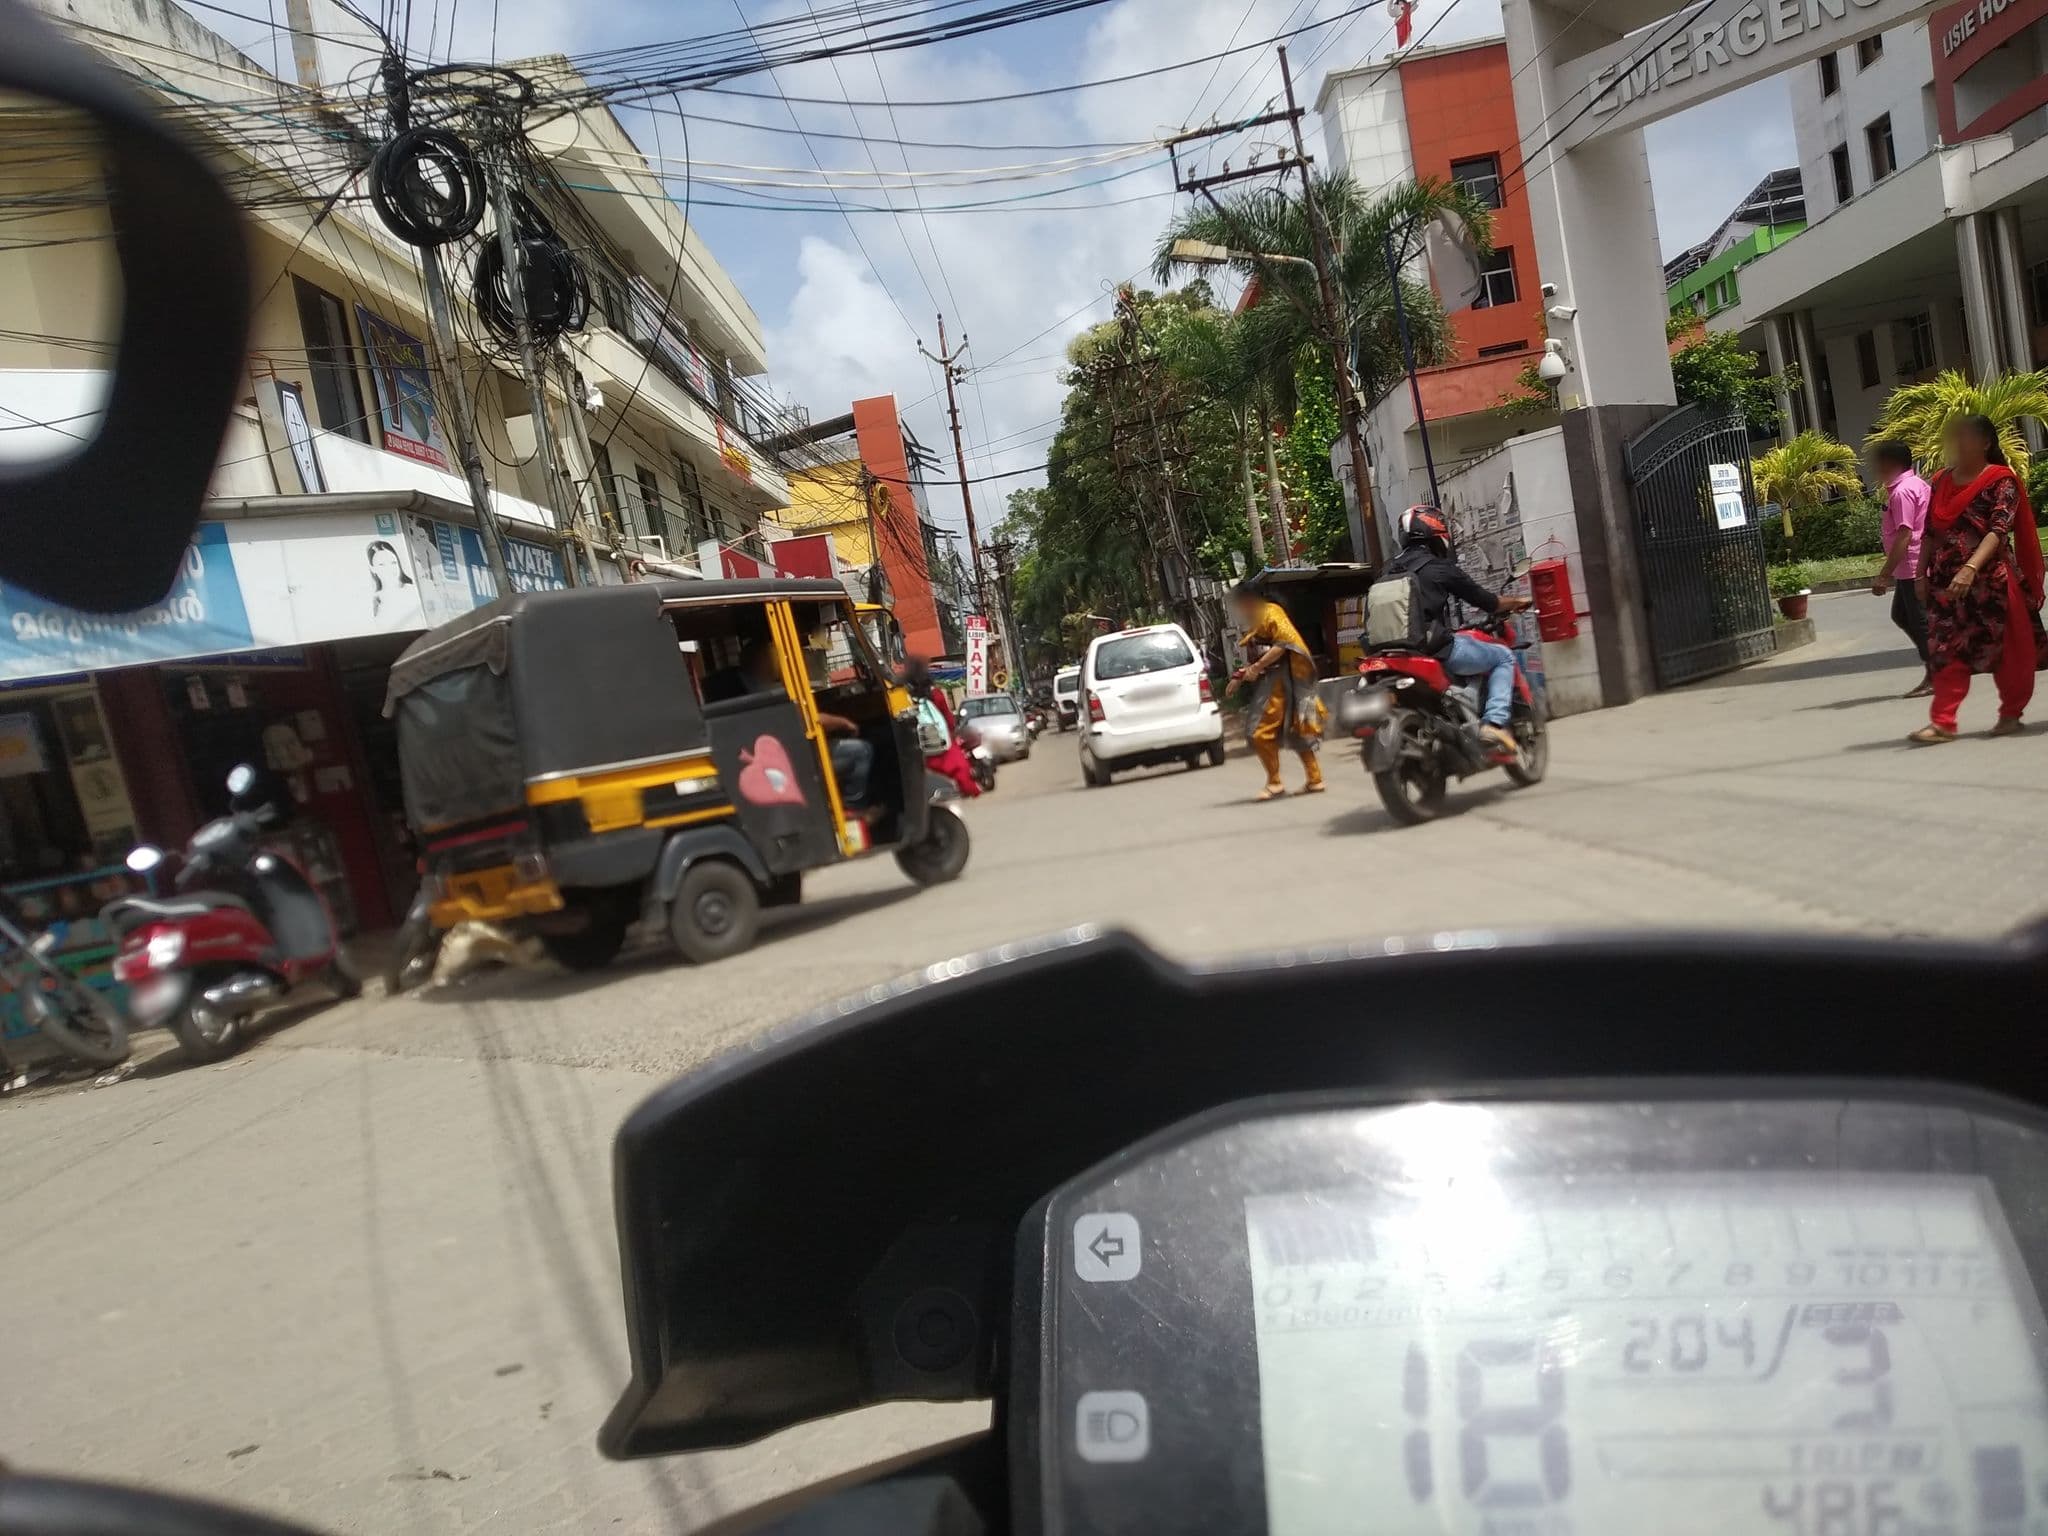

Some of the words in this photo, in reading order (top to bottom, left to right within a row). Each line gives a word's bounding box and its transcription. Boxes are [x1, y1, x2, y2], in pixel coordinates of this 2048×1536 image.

[1588, 0, 1879, 116] EMERGEN
[1943, 9, 1976, 58] LISIE
[1978, 0, 2016, 25] HO
[1718, 502, 1732, 519] WAY
[1732, 501, 1742, 517] IN
[970, 638, 983, 689] TAXI
[1623, 1315, 1755, 1373] 204
[1403, 1339, 1570, 1503] 18
